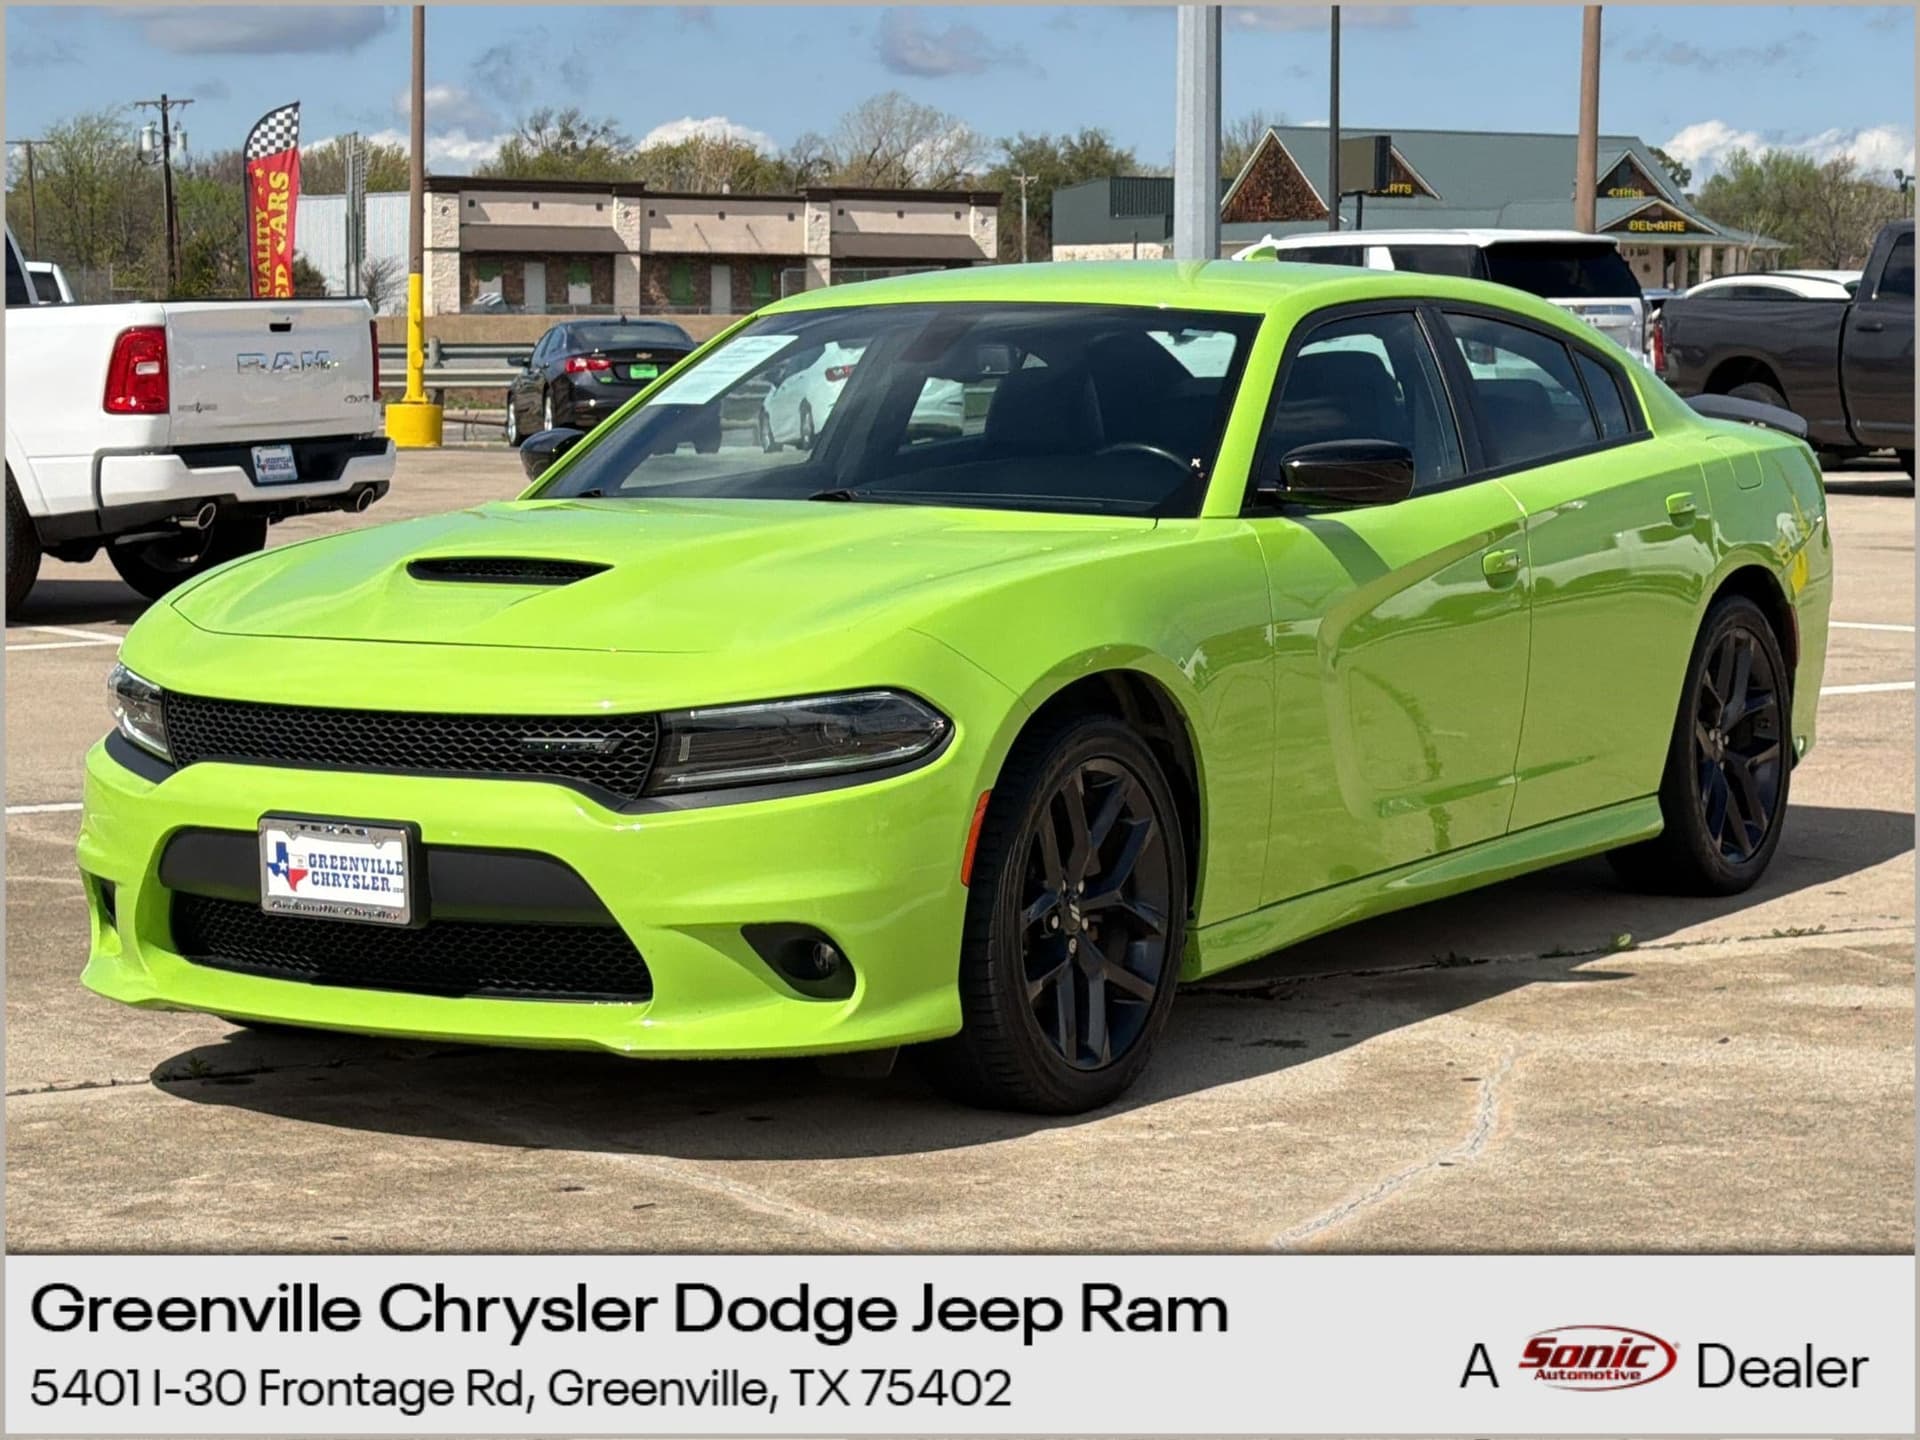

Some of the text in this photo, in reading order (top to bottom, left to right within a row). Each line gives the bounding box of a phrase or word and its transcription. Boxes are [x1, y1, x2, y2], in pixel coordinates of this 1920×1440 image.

[255, 206, 270, 297] UALITY
[236, 350, 332, 374] RAM
[297, 823, 368, 836] TEXAS
[308, 852, 404, 876] GREENVILLE
[311, 871, 391, 893] CHRYSLER
